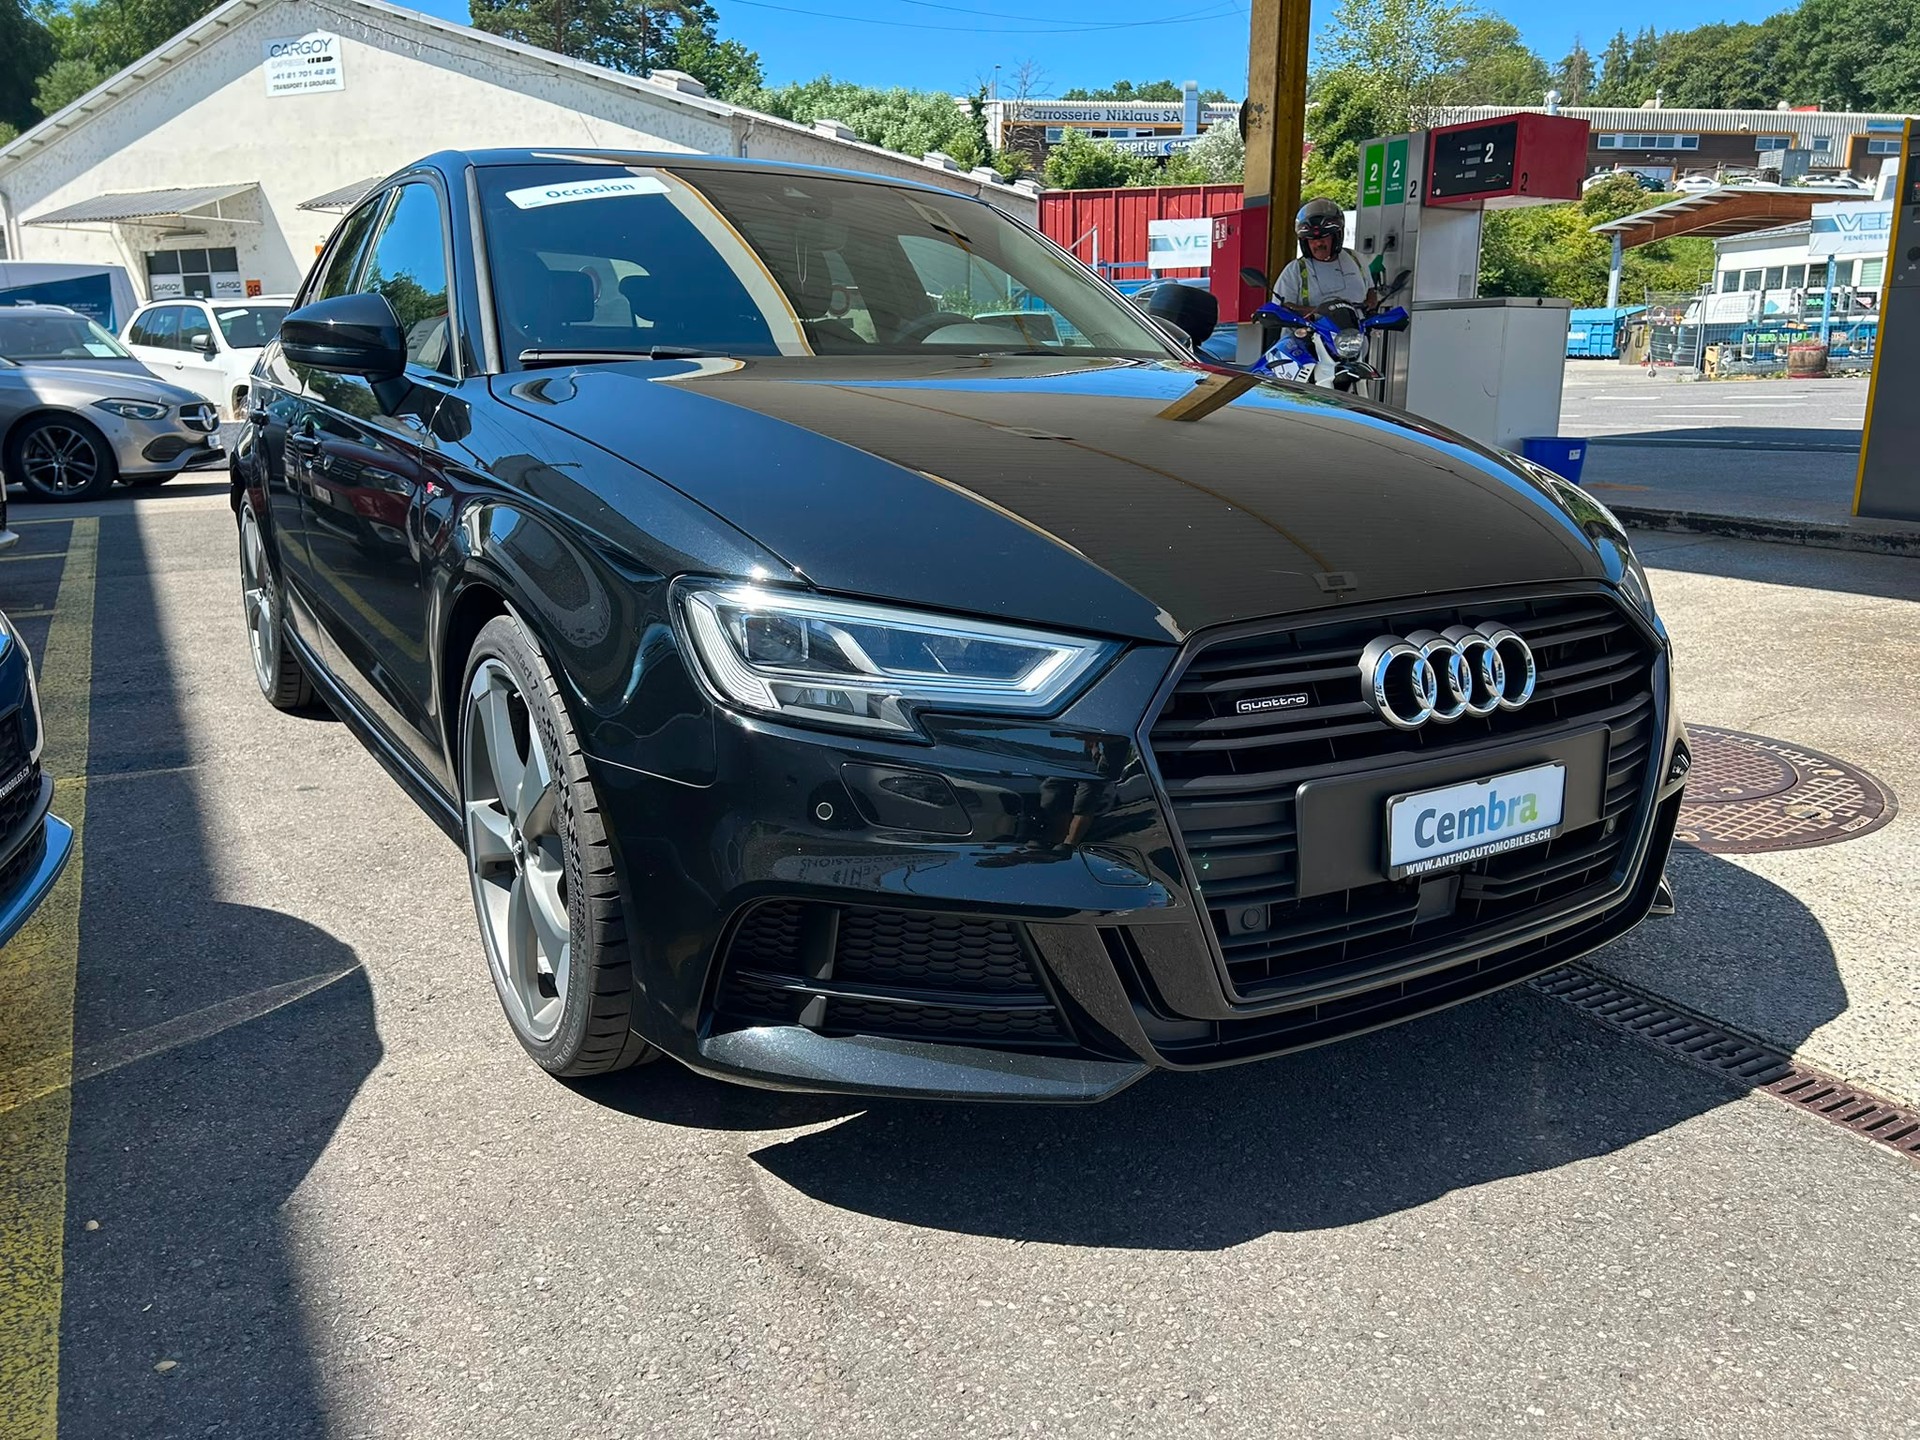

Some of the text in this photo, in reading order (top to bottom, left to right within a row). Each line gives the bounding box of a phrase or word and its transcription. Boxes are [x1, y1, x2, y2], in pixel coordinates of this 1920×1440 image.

[269, 37, 333, 58] CARGOY
[273, 81, 303, 90] TRANSPORT
[1022, 105, 1181, 122] Carrosserie Niklaus SA
[1483, 142, 1495, 163] 2
[1370, 163, 1378, 182] 2
[1392, 159, 1401, 179] 2
[545, 183, 636, 199] Occasion
[1409, 180, 1418, 199] 2
[1519, 171, 1529, 193] 2
[152, 283, 181, 292] CARGOY
[1240, 696, 1306, 711] quattro
[1414, 790, 1538, 849] Cembra
[1406, 828, 1551, 876] WWW.ANTHOAUTOMOBILES.CH
